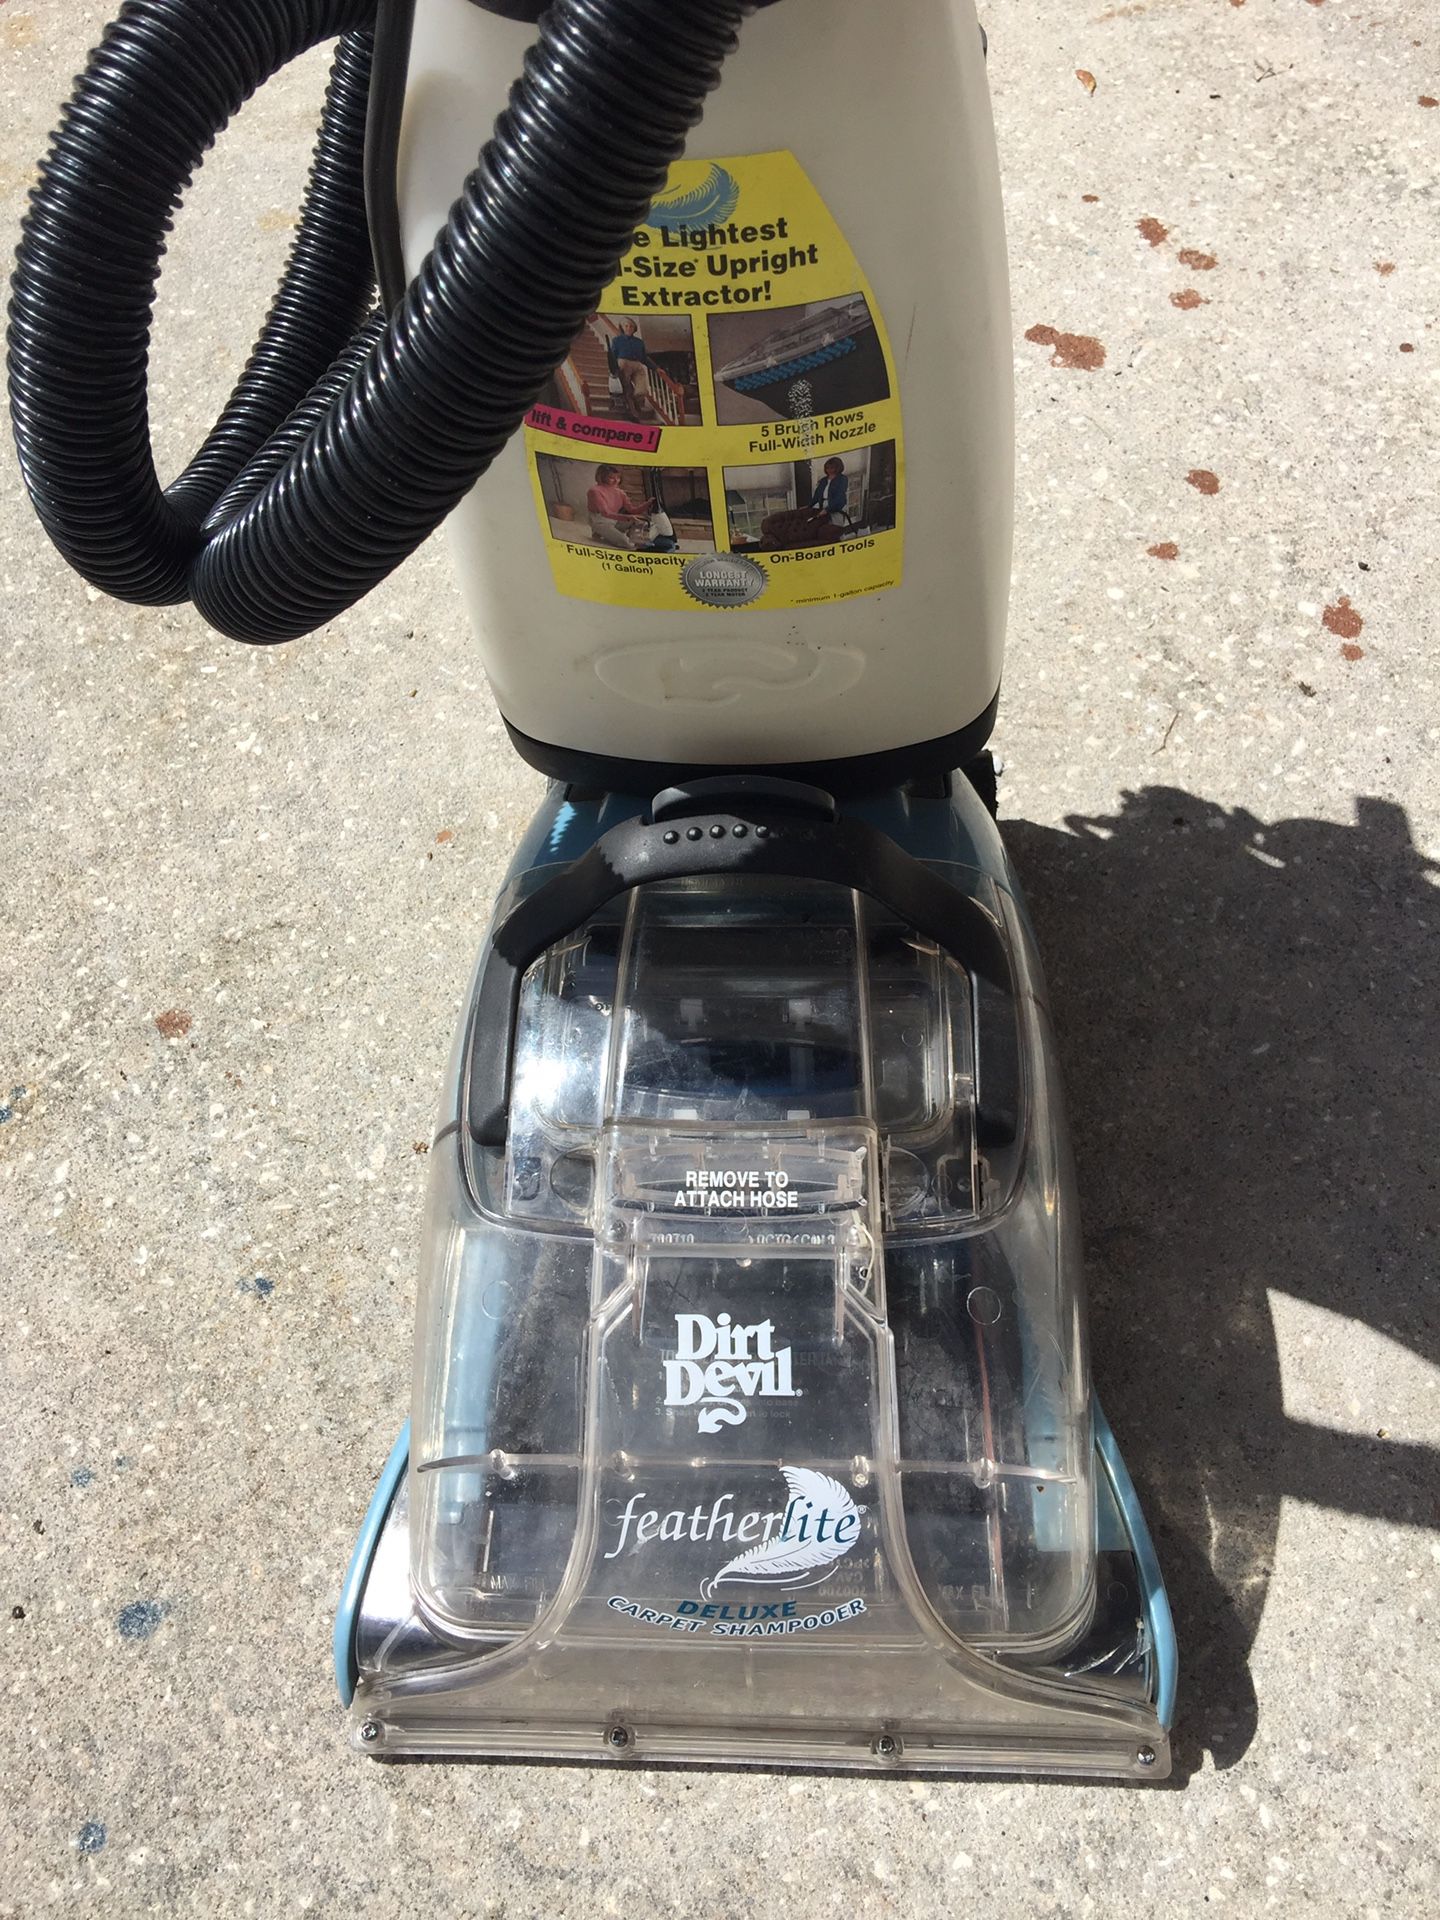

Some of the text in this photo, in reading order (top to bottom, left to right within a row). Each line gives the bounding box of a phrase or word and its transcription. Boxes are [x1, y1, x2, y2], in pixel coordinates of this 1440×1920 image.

[661, 217, 789, 252] Lightest
[706, 244, 819, 279] Upright
[621, 280, 772, 307] Extractor!
[531, 408, 552, 427] lift
[556, 416, 567, 431] &
[572, 422, 643, 443] compare
[761, 425, 770, 438] 5
[824, 411, 864, 429] Rows
[829, 422, 876, 442] Nozzle
[566, 543, 623, 562] Full-Size
[627, 553, 687, 568] Capacity
[769, 546, 835, 564] On-Board
[840, 538, 875, 555] Tools
[602, 562, 654, 576] (1 Gallon)
[700, 570, 747, 579] LONGEST
[694, 579, 754, 588] WARRANTY
[796, 594, 830, 604] minimum
[864, 579, 895, 592] capacity
[685, 1170, 788, 1188] REMOVE TO
[674, 1190, 798, 1208] ATTACH HOSE
[675, 1312, 775, 1360] Dirt
[663, 1346, 795, 1406] Devil
[603, 1492, 858, 1559] featherlite
[607, 1595, 867, 1637] CARPET SHAMPOOER
[676, 1600, 797, 1620] DELUXE
